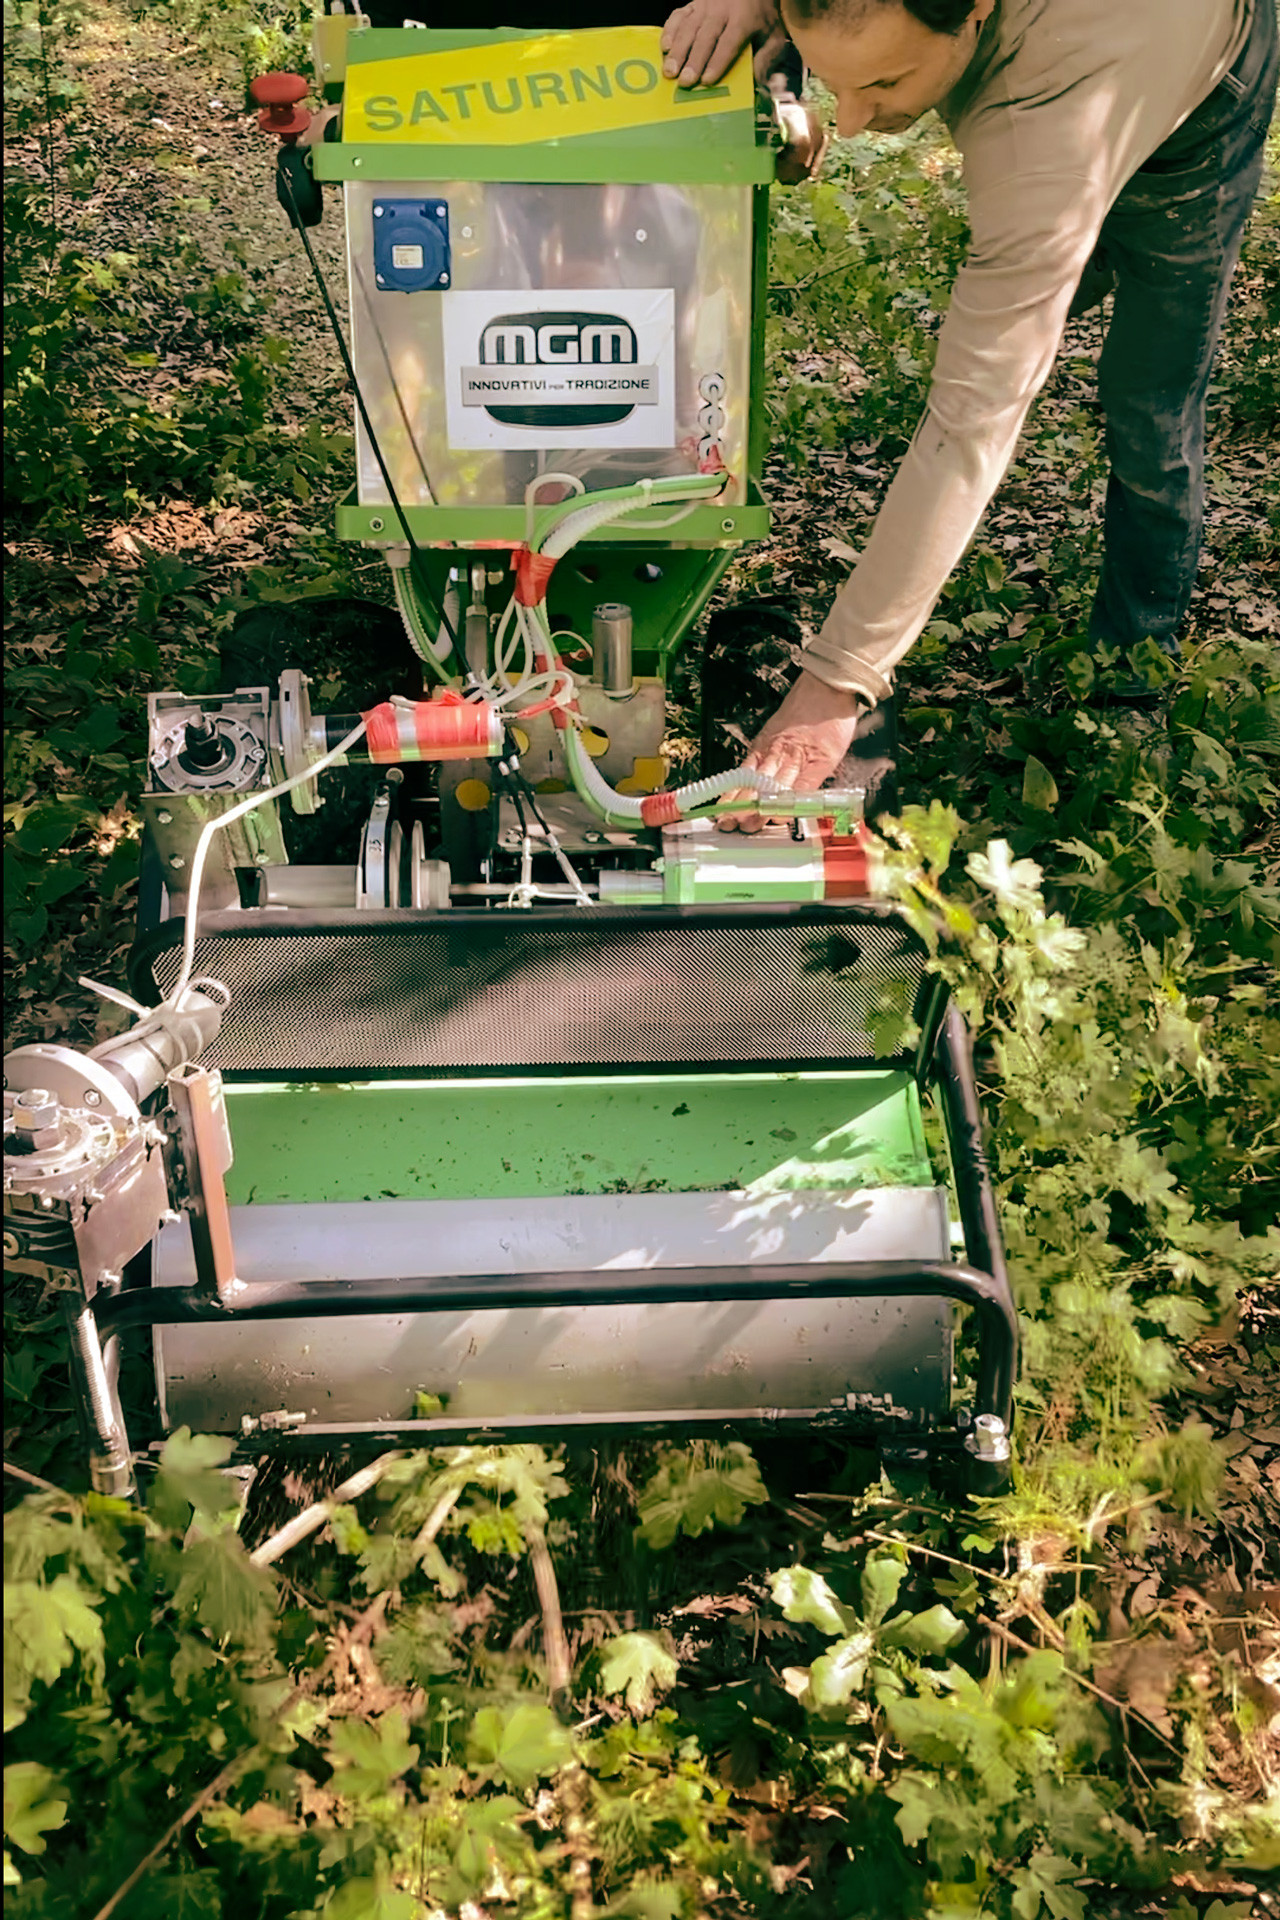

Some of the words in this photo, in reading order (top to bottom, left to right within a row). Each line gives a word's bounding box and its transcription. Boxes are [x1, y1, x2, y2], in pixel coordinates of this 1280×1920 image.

[363, 59, 658, 132] SATURNO
[484, 324, 633, 364] MGM
[468, 379, 546, 391] INNOVATIVI
[565, 378, 650, 390] TRADIZIONE
